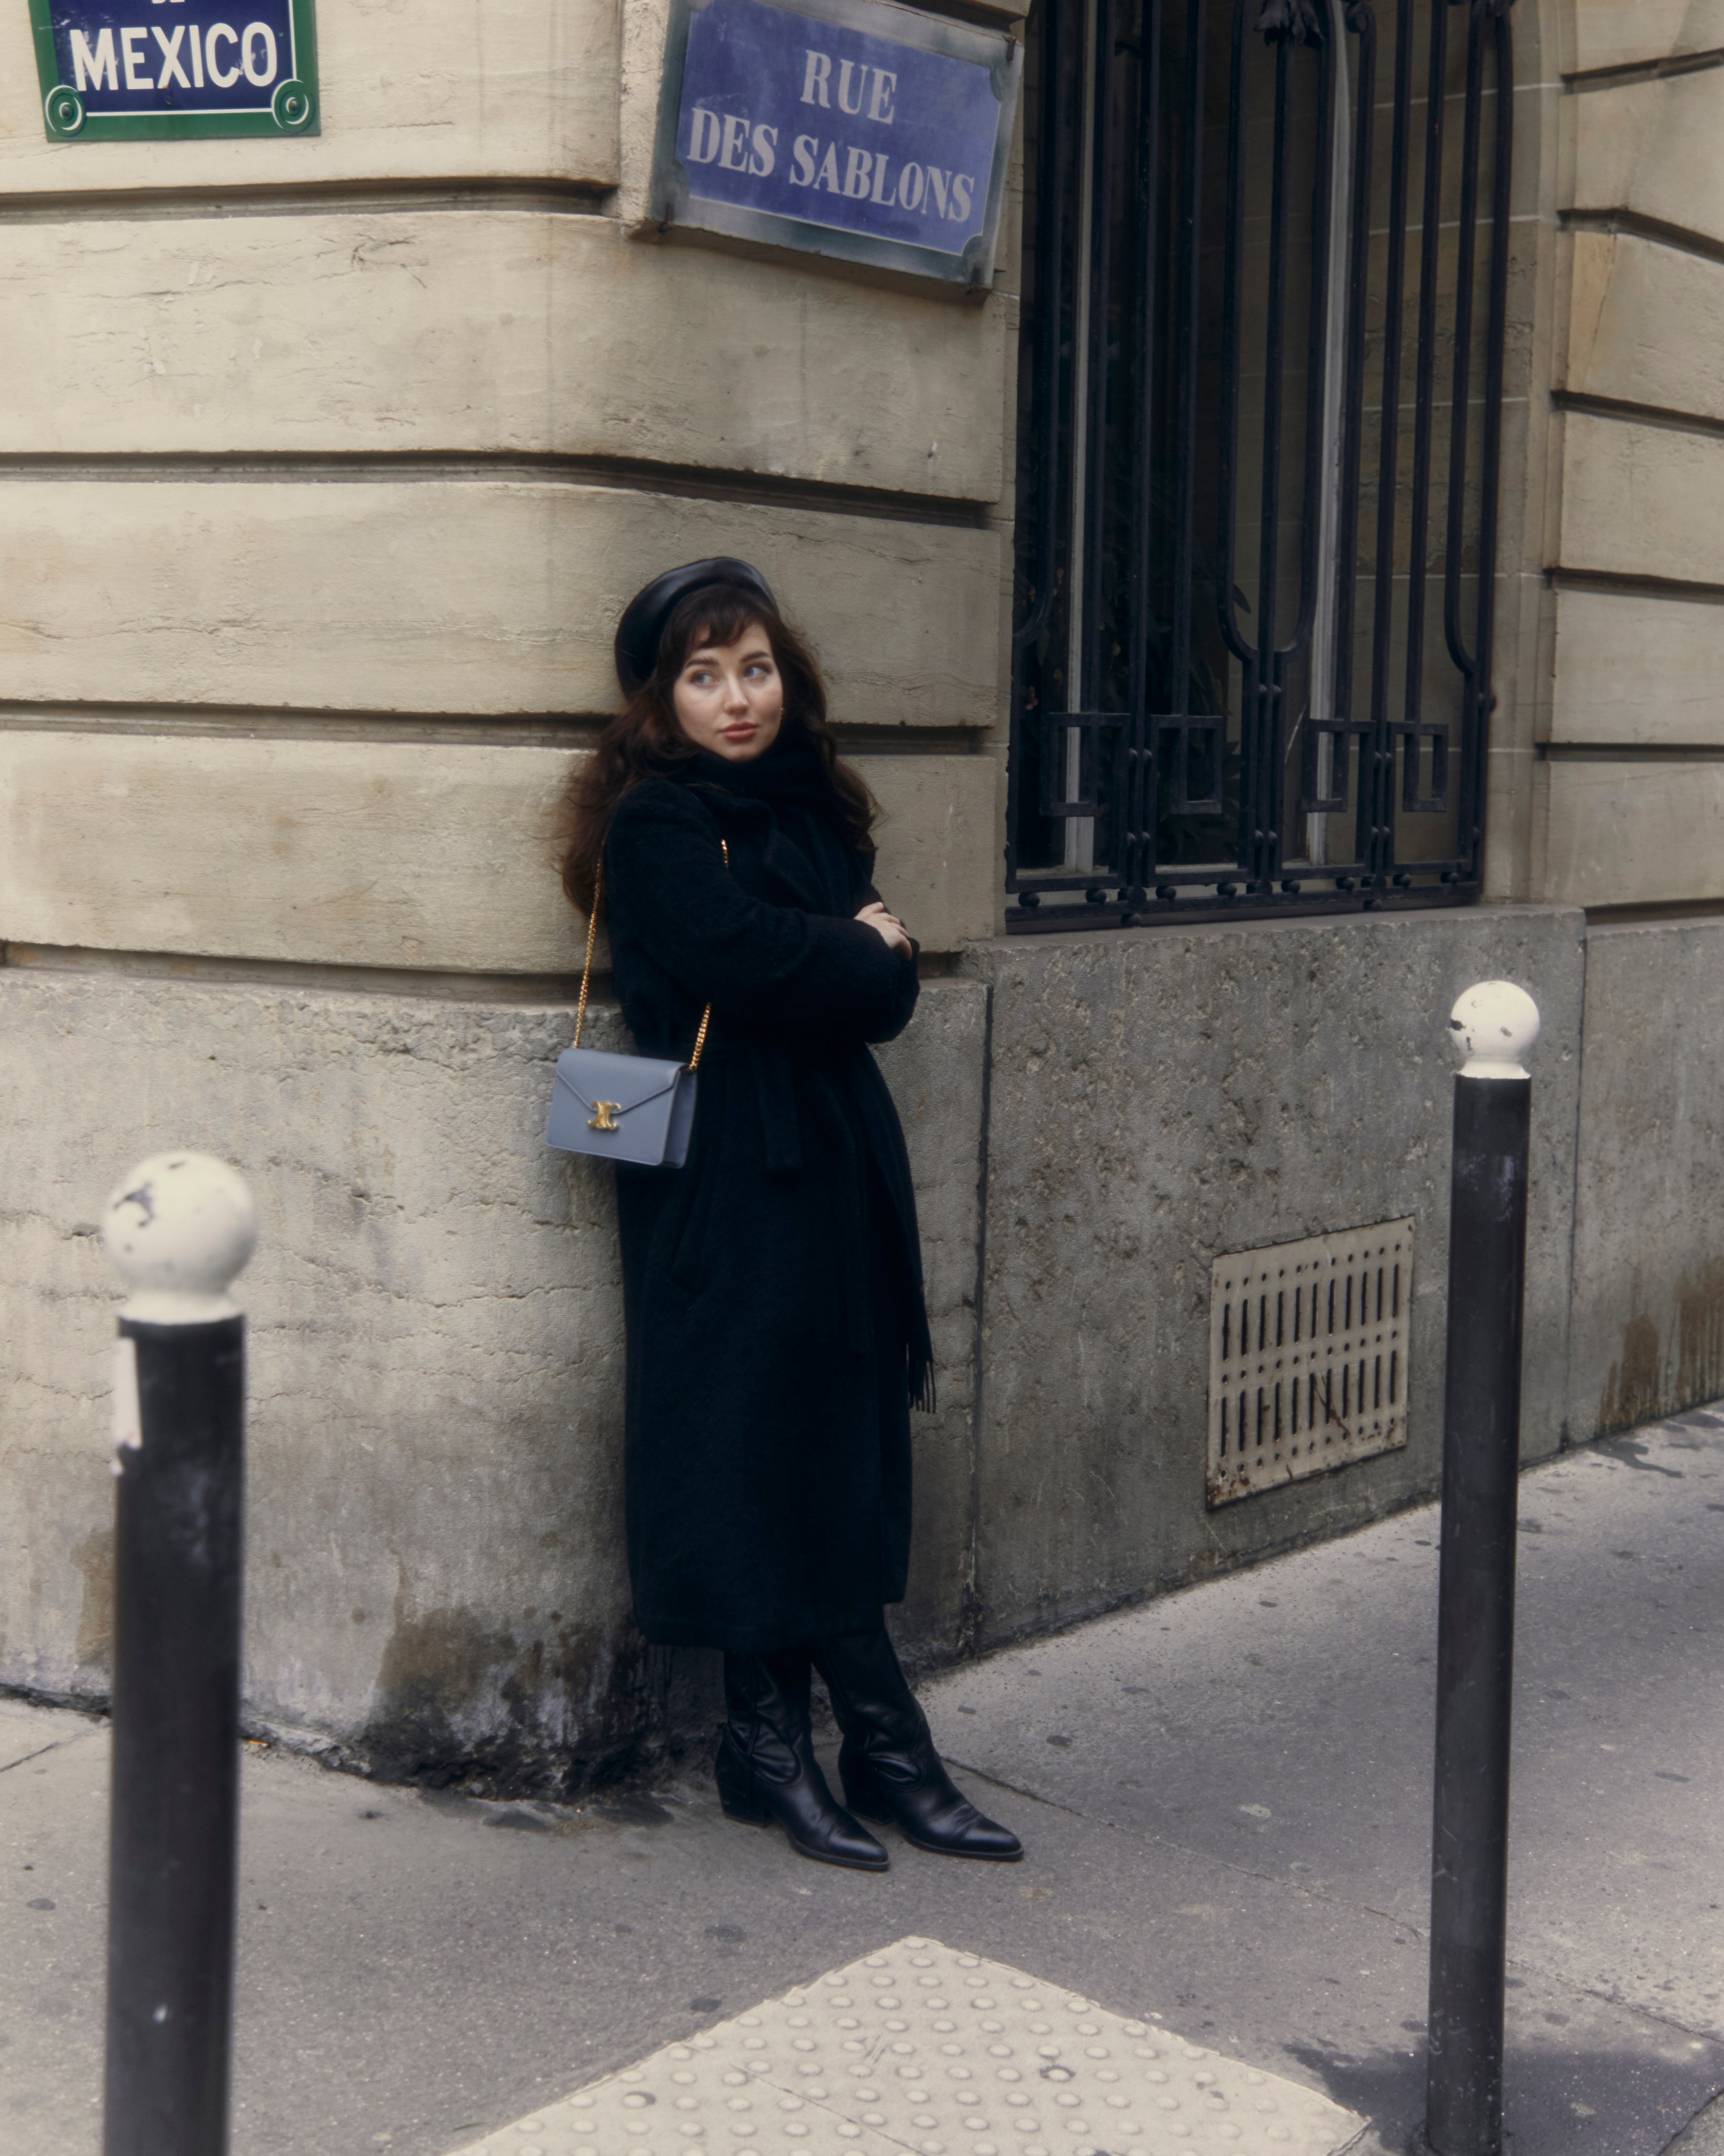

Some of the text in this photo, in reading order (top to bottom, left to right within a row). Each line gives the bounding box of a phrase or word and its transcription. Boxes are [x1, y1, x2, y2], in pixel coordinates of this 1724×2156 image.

[69, 22, 277, 91] MEXICO
[800, 49, 897, 124] RUE
[687, 107, 974, 222] DES SABLONS
